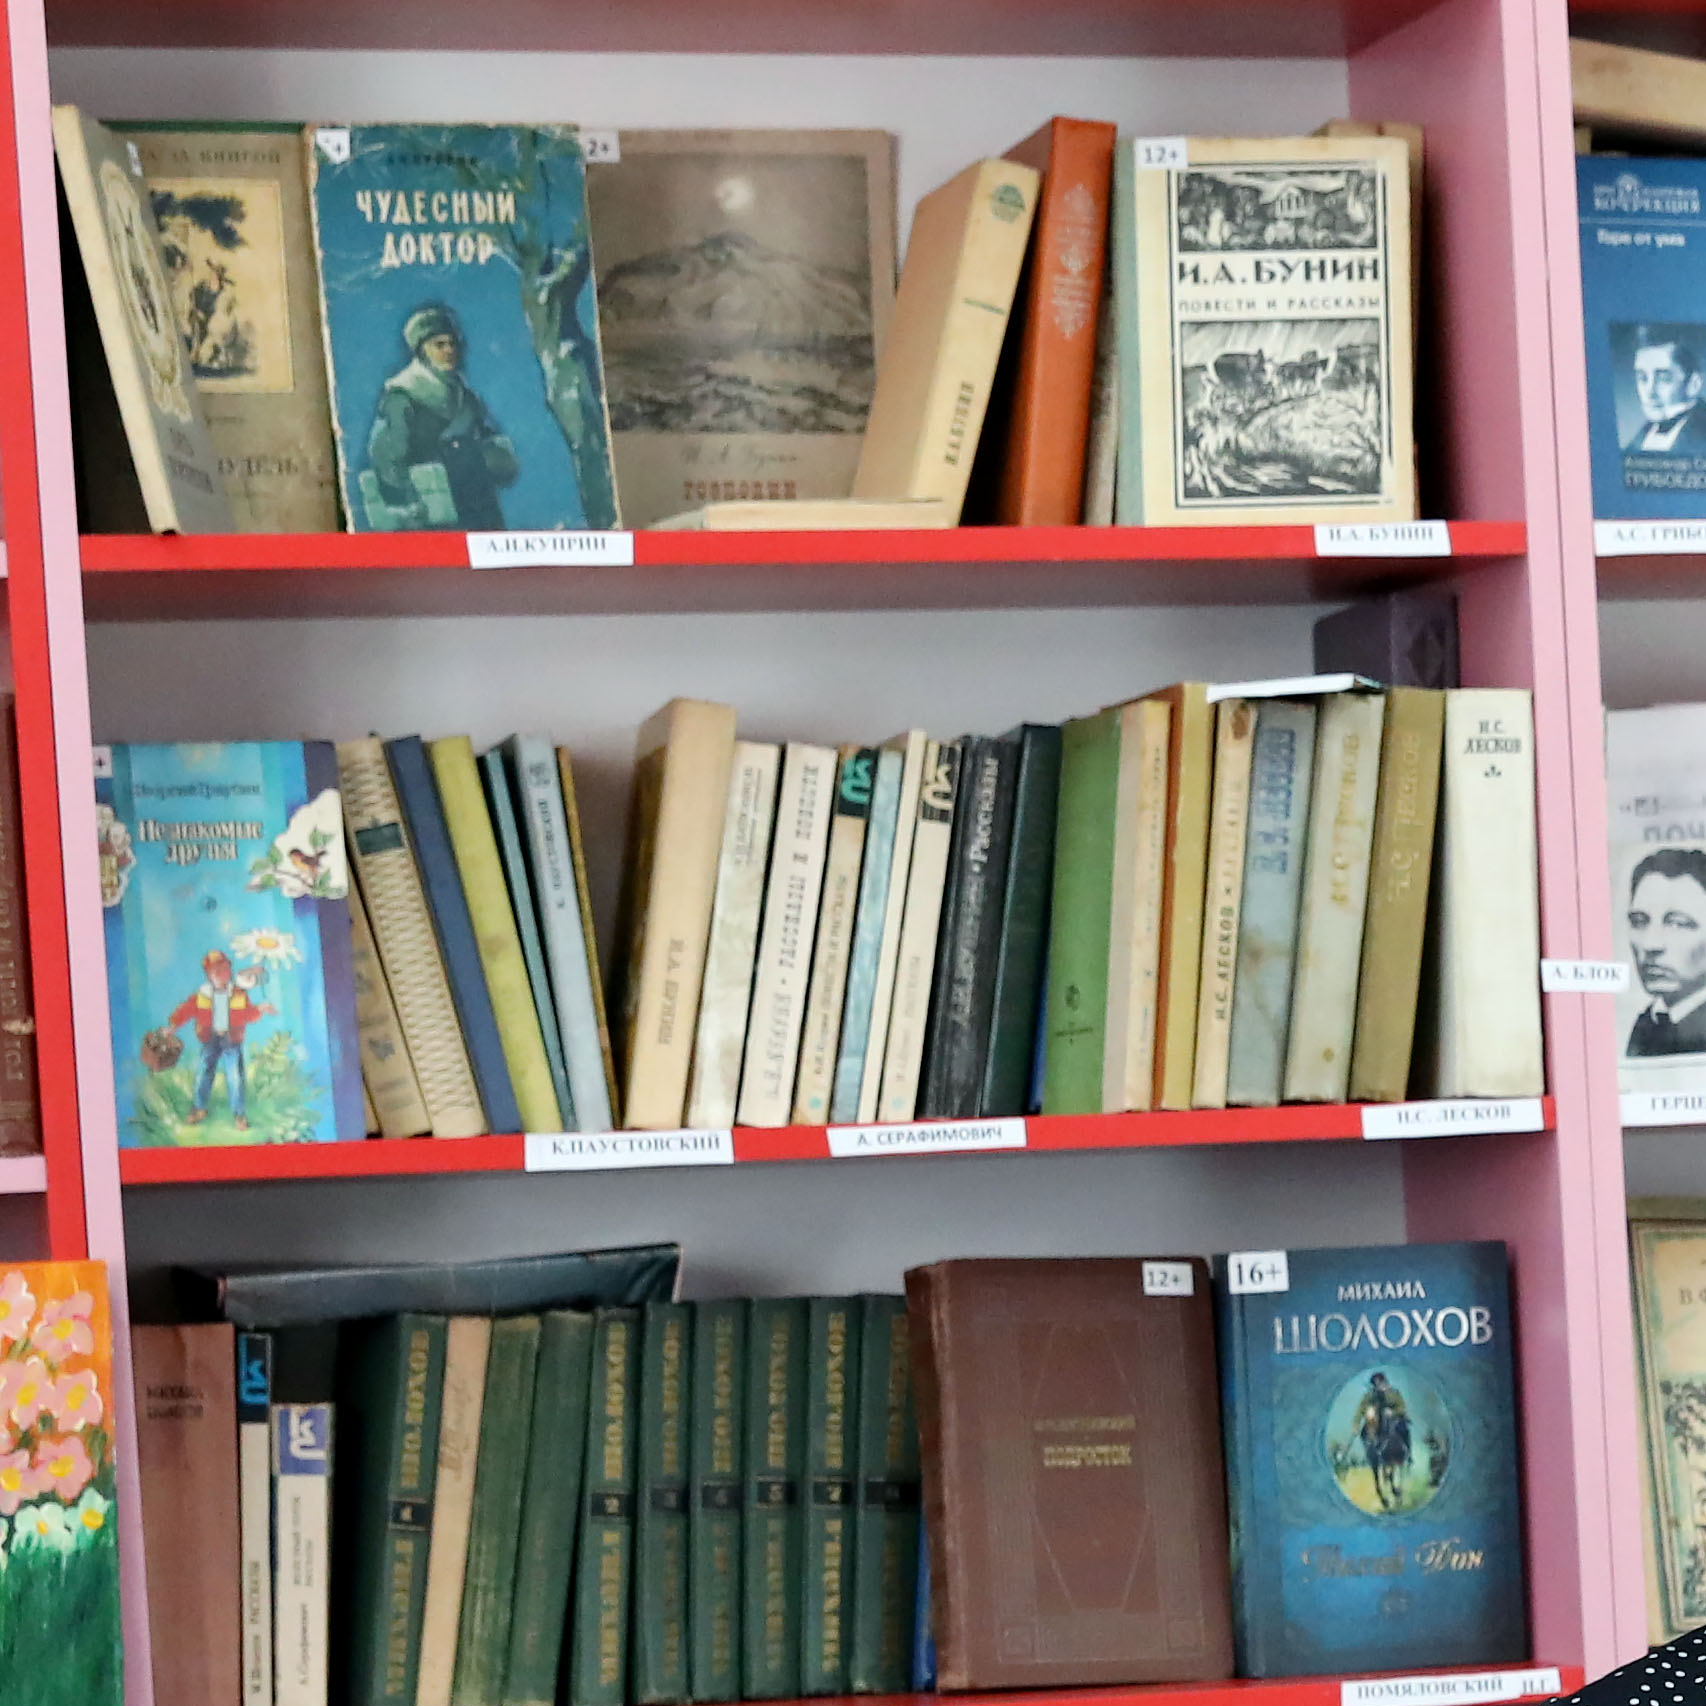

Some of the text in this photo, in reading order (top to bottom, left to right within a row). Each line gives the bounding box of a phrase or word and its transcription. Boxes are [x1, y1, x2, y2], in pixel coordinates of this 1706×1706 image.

[1144, 146, 1179, 165] 12+
[356, 183, 517, 224] ЧУДЕСНЫЙ
[380, 233, 494, 268] ДОКТОР
[1178, 297, 1380, 313] ПОВЕСТИ И РАССКАЗЫ
[1368, 526, 1434, 542] БУНИН
[1464, 737, 1522, 755] ЛЕСКОВ
[1551, 965, 1623, 982] А. БЛОК
[1436, 1106, 1512, 1123] ЛЕСКОВ
[551, 1132, 721, 1156] К.ПАУСТОВСКИЙ
[877, 1126, 1003, 1146] СЕРАФИМОВИЧ
[1147, 1270, 1182, 1288] 12+
[1235, 1260, 1282, 1287] 16+
[1337, 1279, 1426, 1302] МИХАИЛ
[1273, 1306, 1494, 1355] ШОЛОХОВ
[1356, 1678, 1503, 1699] ПОМЯЛОВСКИЙ
